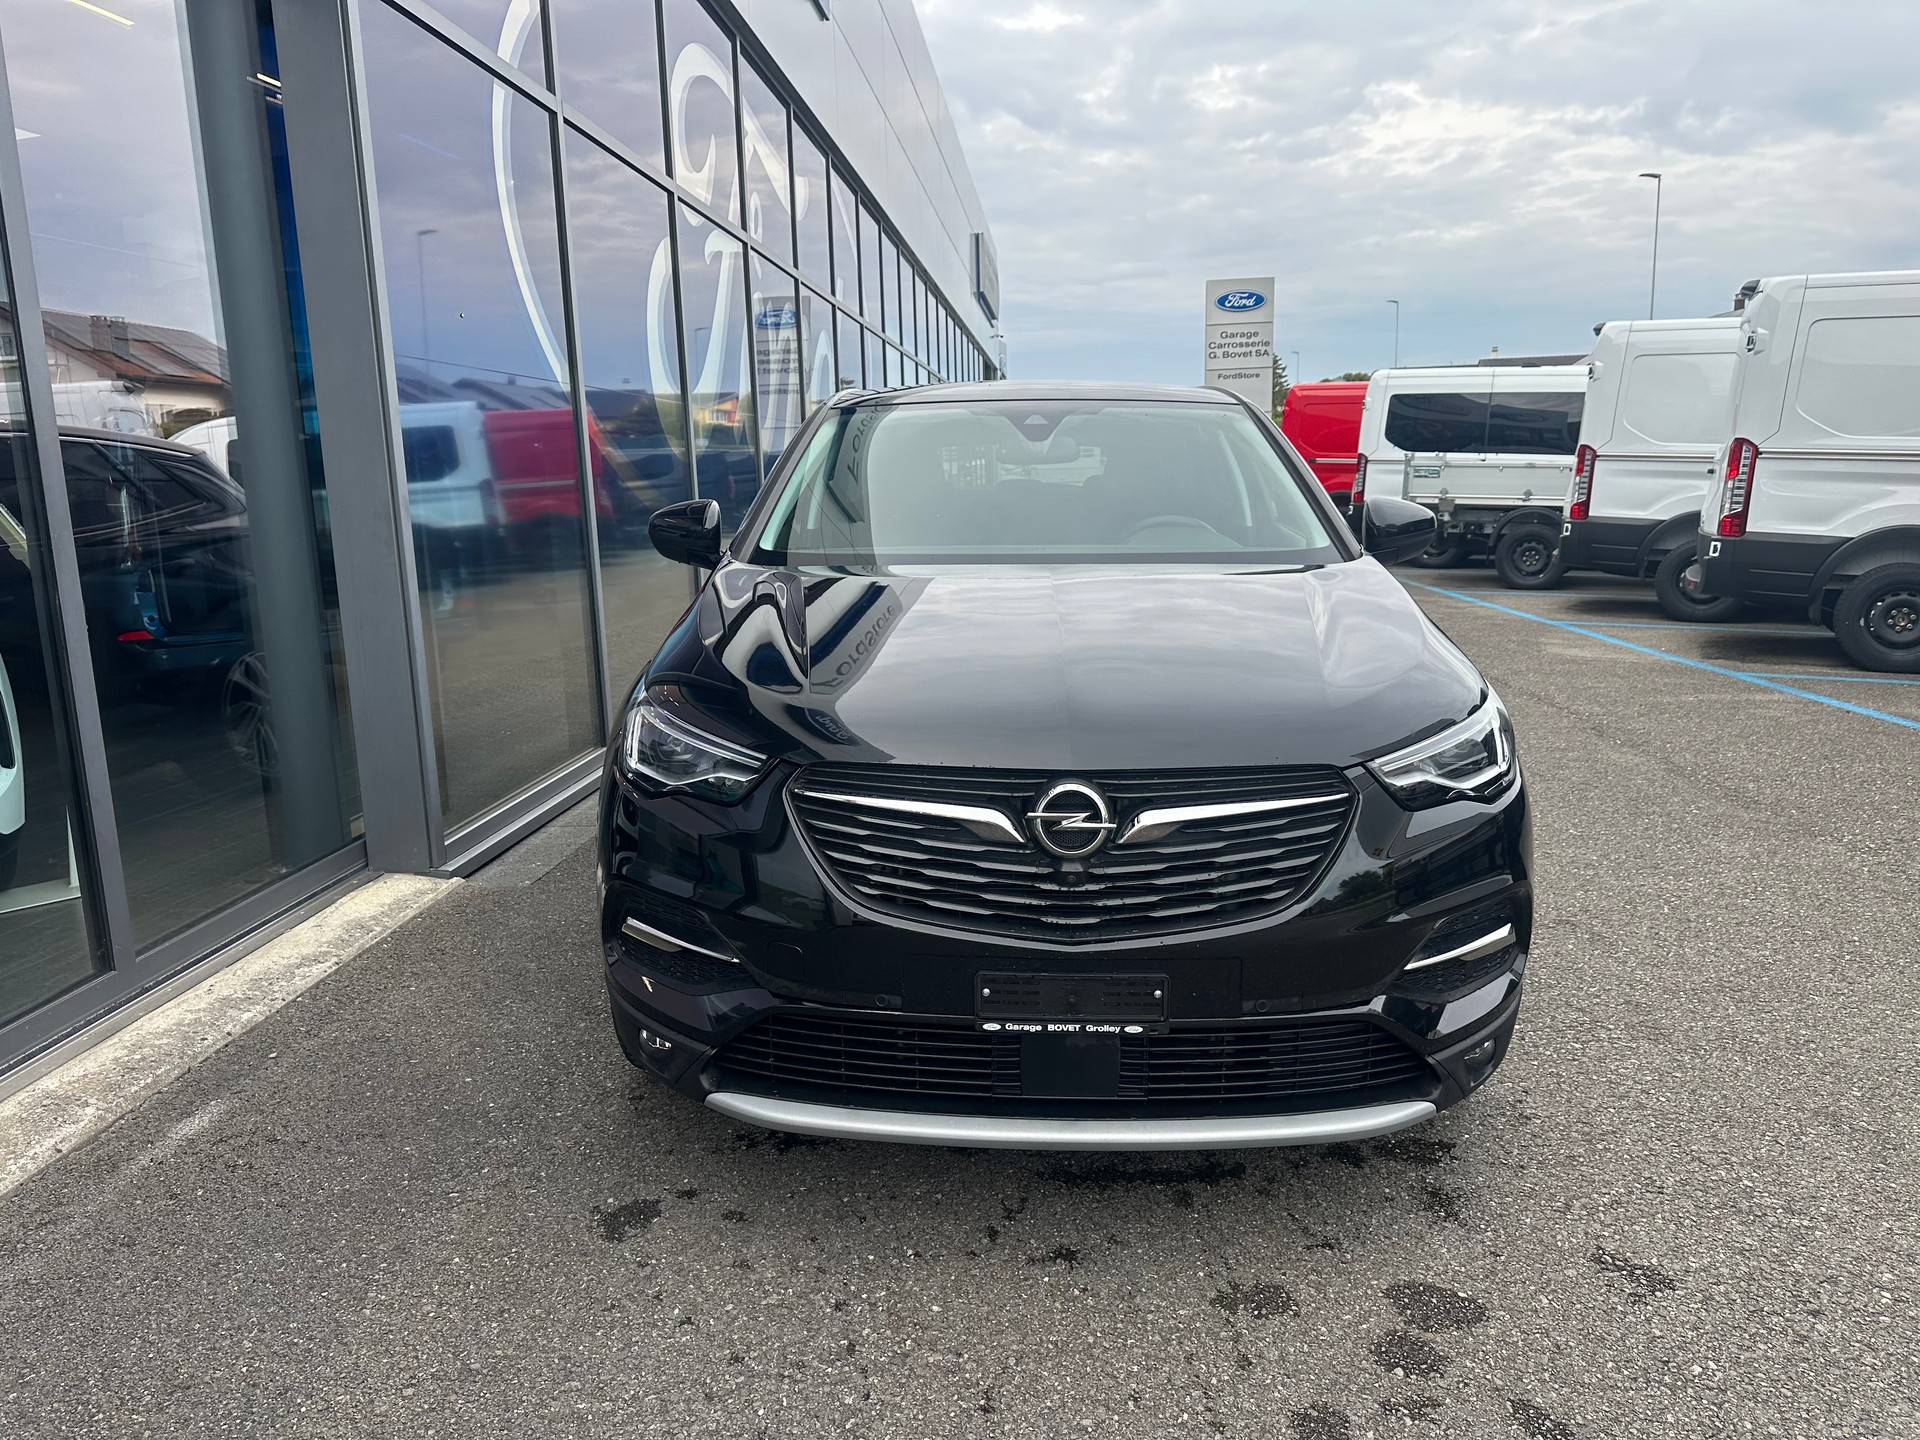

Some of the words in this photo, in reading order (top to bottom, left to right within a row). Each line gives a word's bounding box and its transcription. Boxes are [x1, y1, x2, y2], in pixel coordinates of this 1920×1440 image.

[1225, 293, 1257, 307] Ford
[1220, 330, 1259, 340] Garage
[1208, 339, 1271, 350] Carrosserie
[1208, 351, 1220, 360] G.
[1222, 350, 1253, 359] Bovet
[1254, 349, 1270, 358] SA
[1217, 372, 1261, 381] FordStore
[1005, 1023, 1043, 1033] Garage
[1047, 1024, 1081, 1032] BOVET
[1085, 1024, 1121, 1034] Grolley
